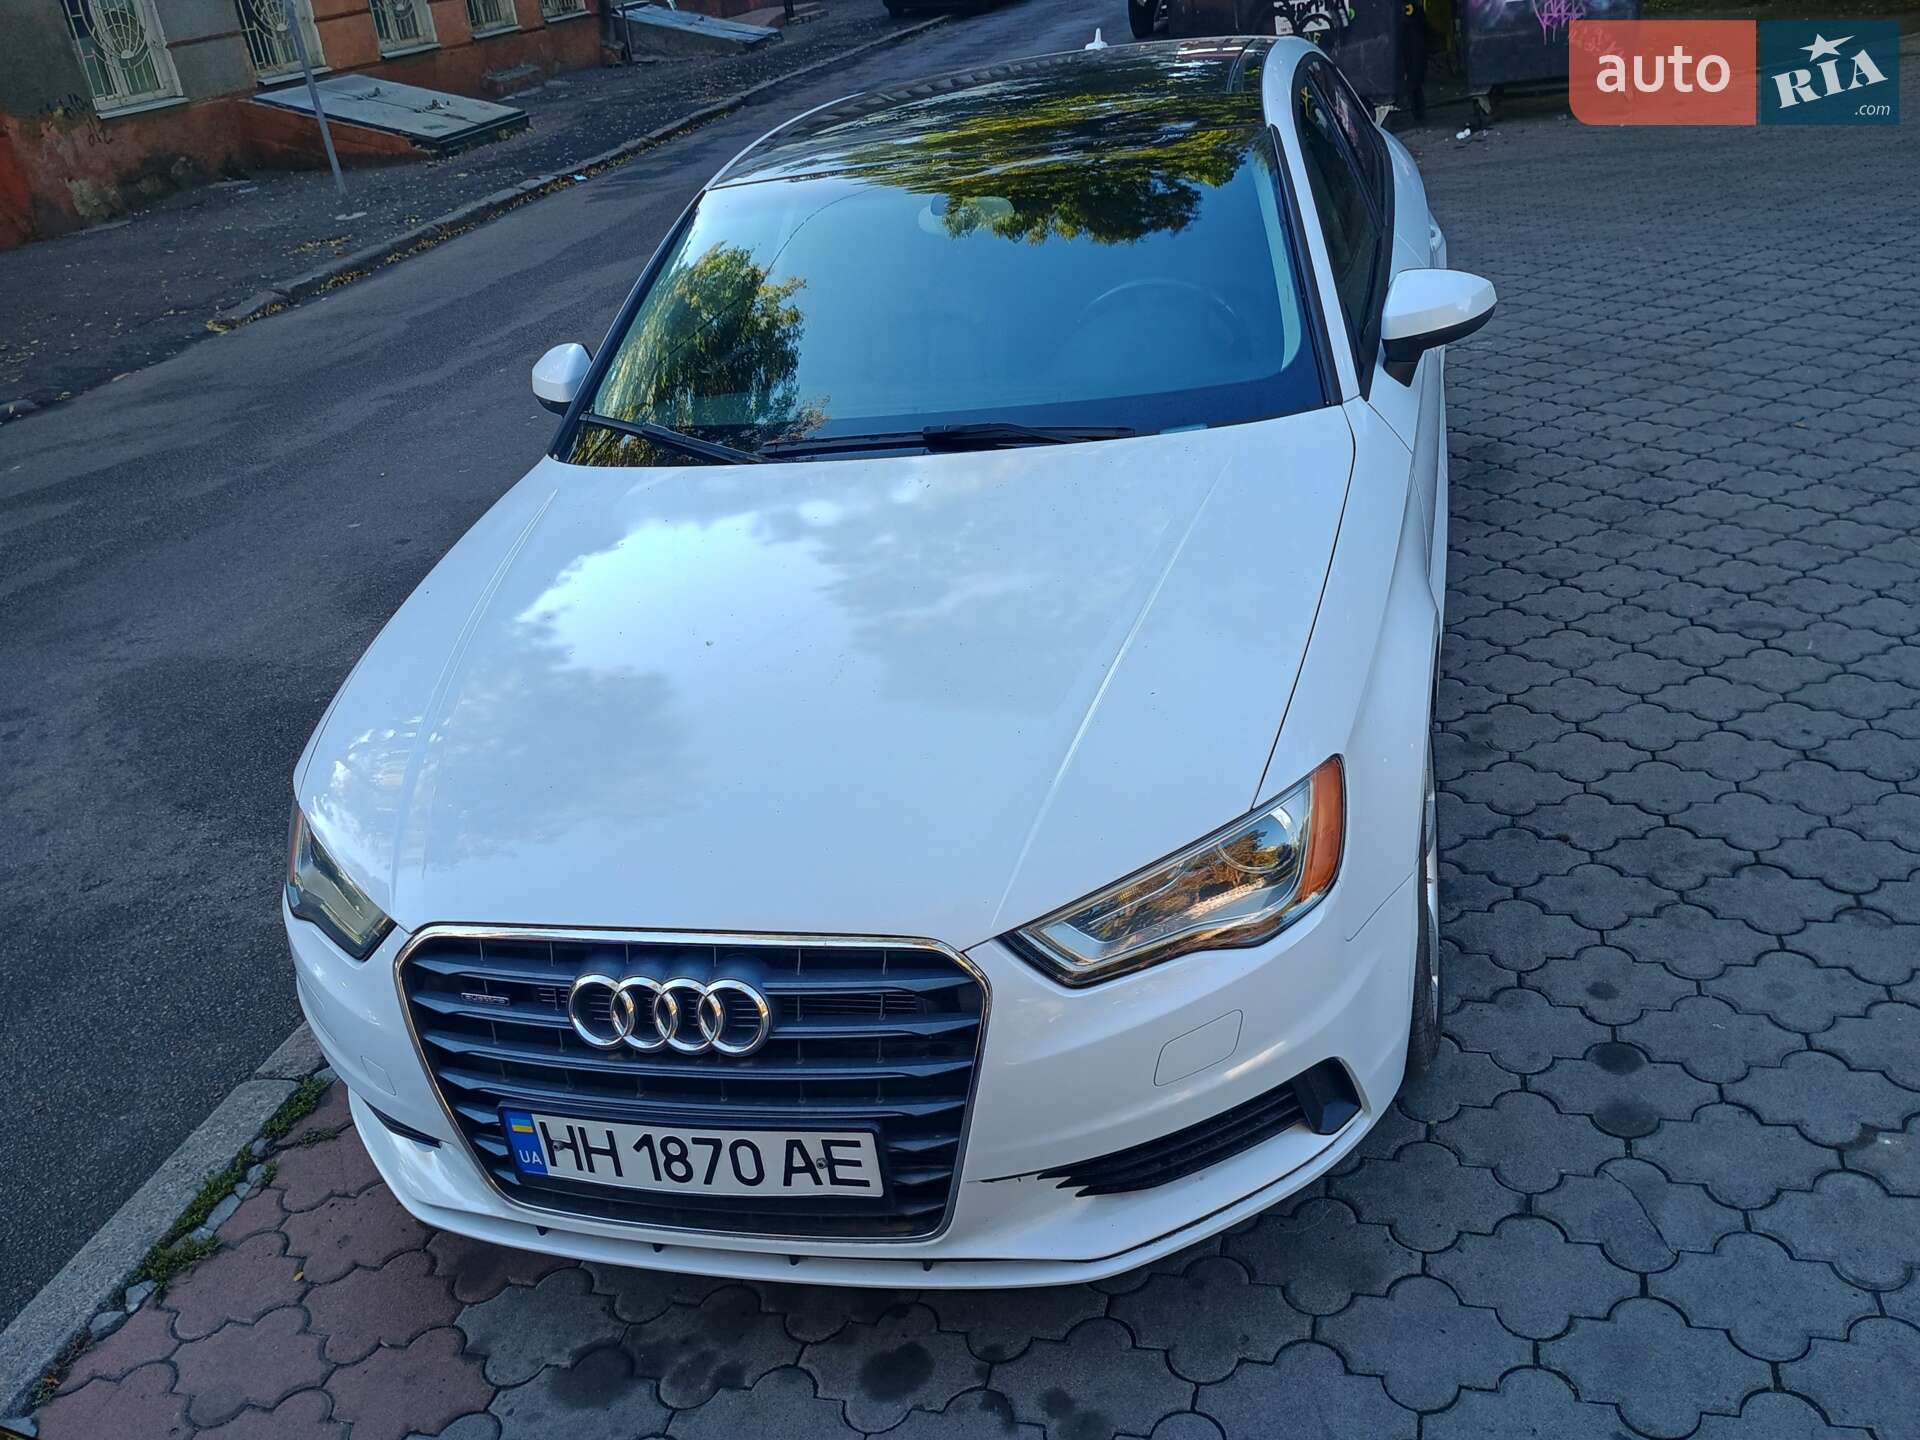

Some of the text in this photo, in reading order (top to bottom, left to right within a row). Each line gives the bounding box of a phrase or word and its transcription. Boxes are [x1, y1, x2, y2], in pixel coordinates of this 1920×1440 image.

[519, 1150, 543, 1165] UA
[539, 1121, 871, 1187] HH 1870 AE
